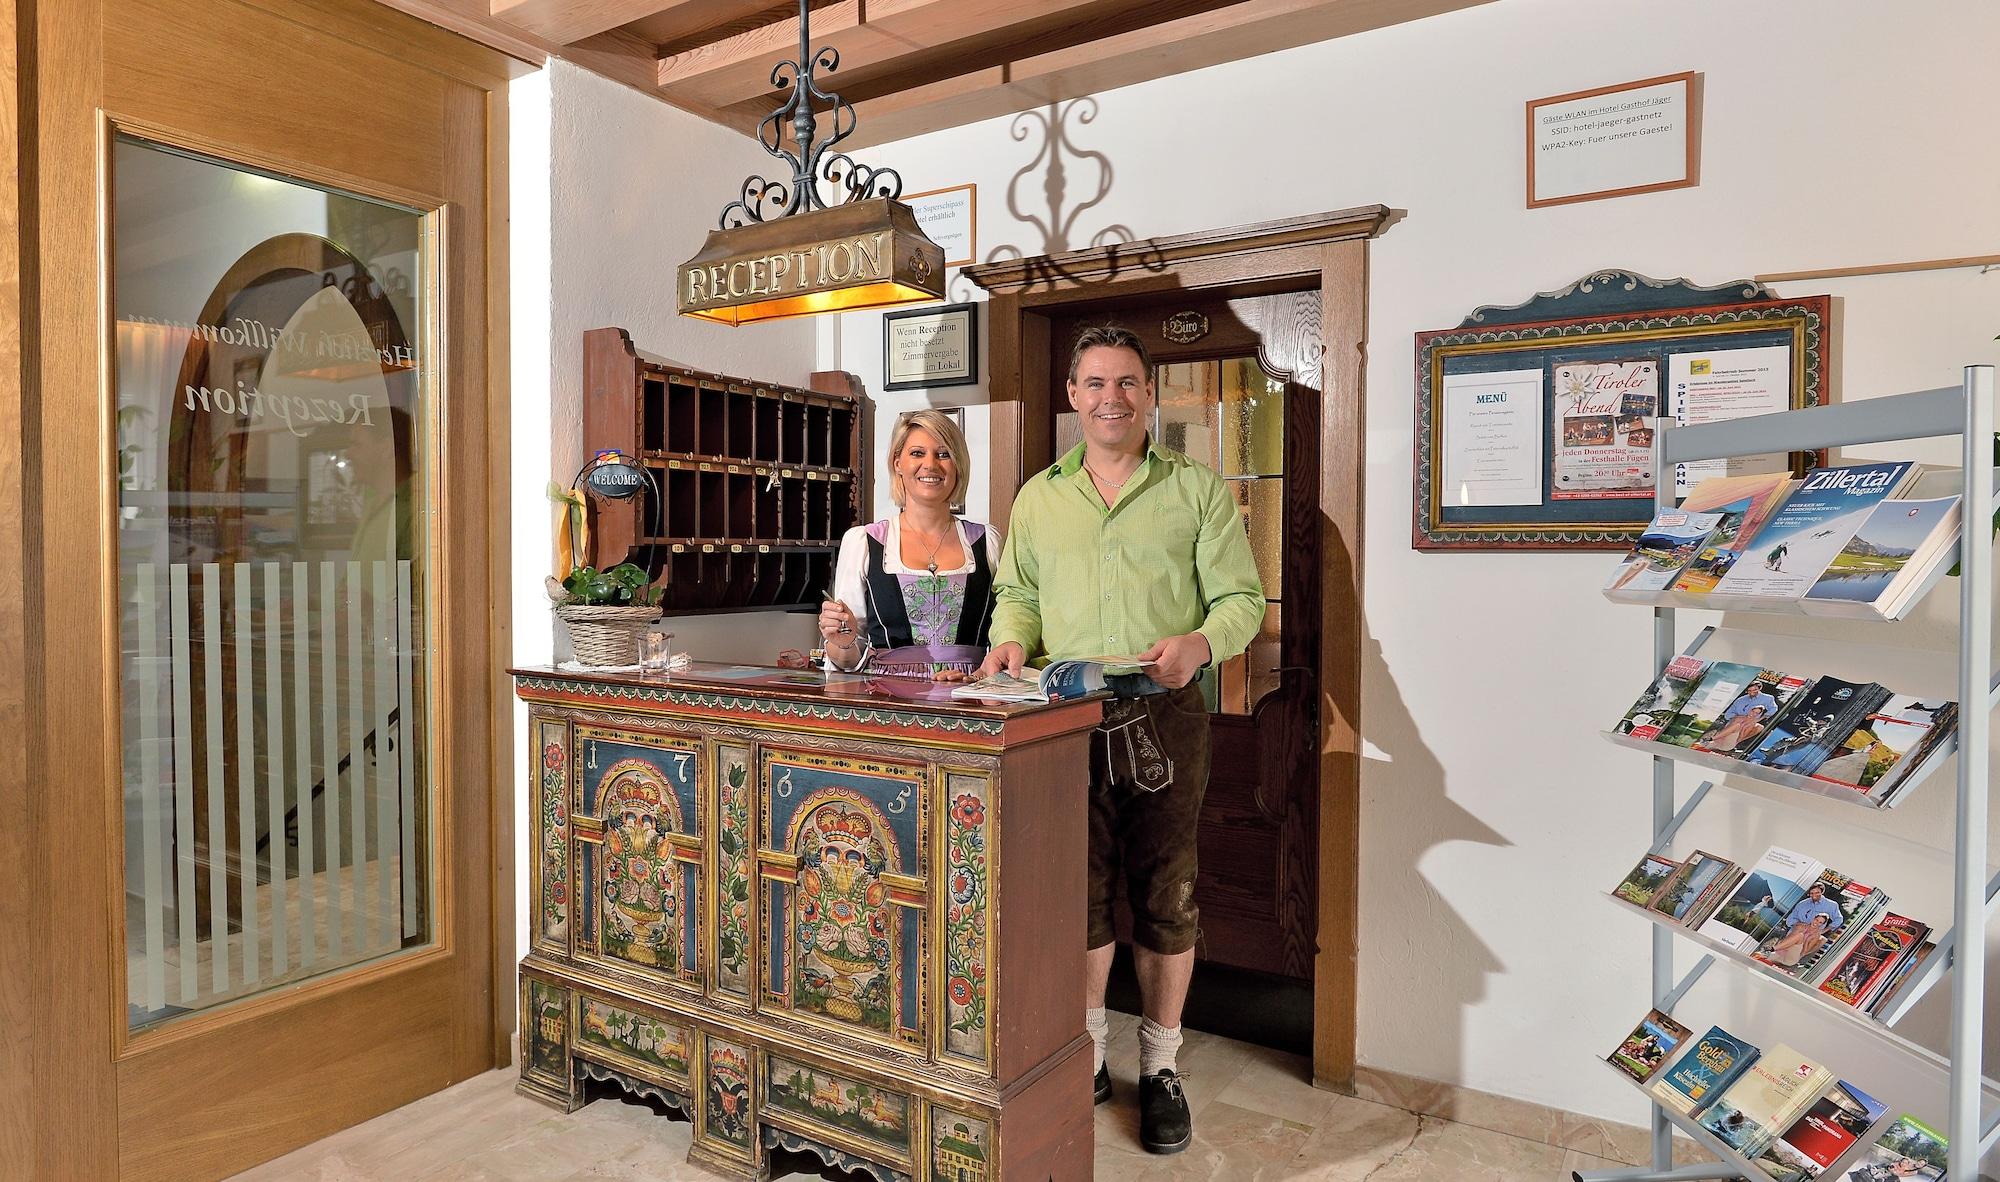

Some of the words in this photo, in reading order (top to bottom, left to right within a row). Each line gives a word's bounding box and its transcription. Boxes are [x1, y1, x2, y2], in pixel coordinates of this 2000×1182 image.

[1542, 115, 1563, 124] Gäste
[1565, 110, 1587, 119] WLAN
[1588, 108, 1598, 116] im
[1599, 103, 1620, 114] Hotel
[1620, 98, 1651, 110] Gasthof
[1651, 95, 1672, 106] Jäger
[1551, 126, 1572, 136] SSID:
[1573, 111, 1663, 132] hotel-jaeger-gastnetz
[1541, 139, 1586, 152] WPA2-Key:
[1588, 134, 1607, 144] Fuer
[1608, 130, 1638, 141] unsere
[1639, 123, 1674, 136] Gaeste!
[686, 232, 884, 305] RECEPTION
[896, 328, 917, 336] Wenn
[919, 323, 957, 335] Reception
[1169, 319, 1198, 335] Büro
[900, 340, 918, 349] nicht
[919, 337, 945, 347] besetzt
[902, 347, 959, 361] Zimmervergabe
[926, 362, 936, 371] im
[938, 360, 960, 370] Lokal
[1592, 365, 1647, 391] Tiroler
[1476, 392, 1508, 404] MENÜ
[1563, 389, 1628, 416] Abend
[1562, 449, 1582, 458] jeden
[1584, 447, 1627, 456] Donnerstag
[1626, 455, 1649, 464] Fügen
[593, 474, 638, 486] WELCOME
[1804, 465, 1903, 491] Zillertal
[1843, 487, 1885, 497] Magazin
[587, 740, 599, 770] 1
[673, 753, 692, 783] 7
[776, 768, 793, 798] 6
[887, 785, 912, 815] 5
[1699, 1040, 1723, 1060] Gold
[1696, 1051, 1726, 1074] Bergbau
